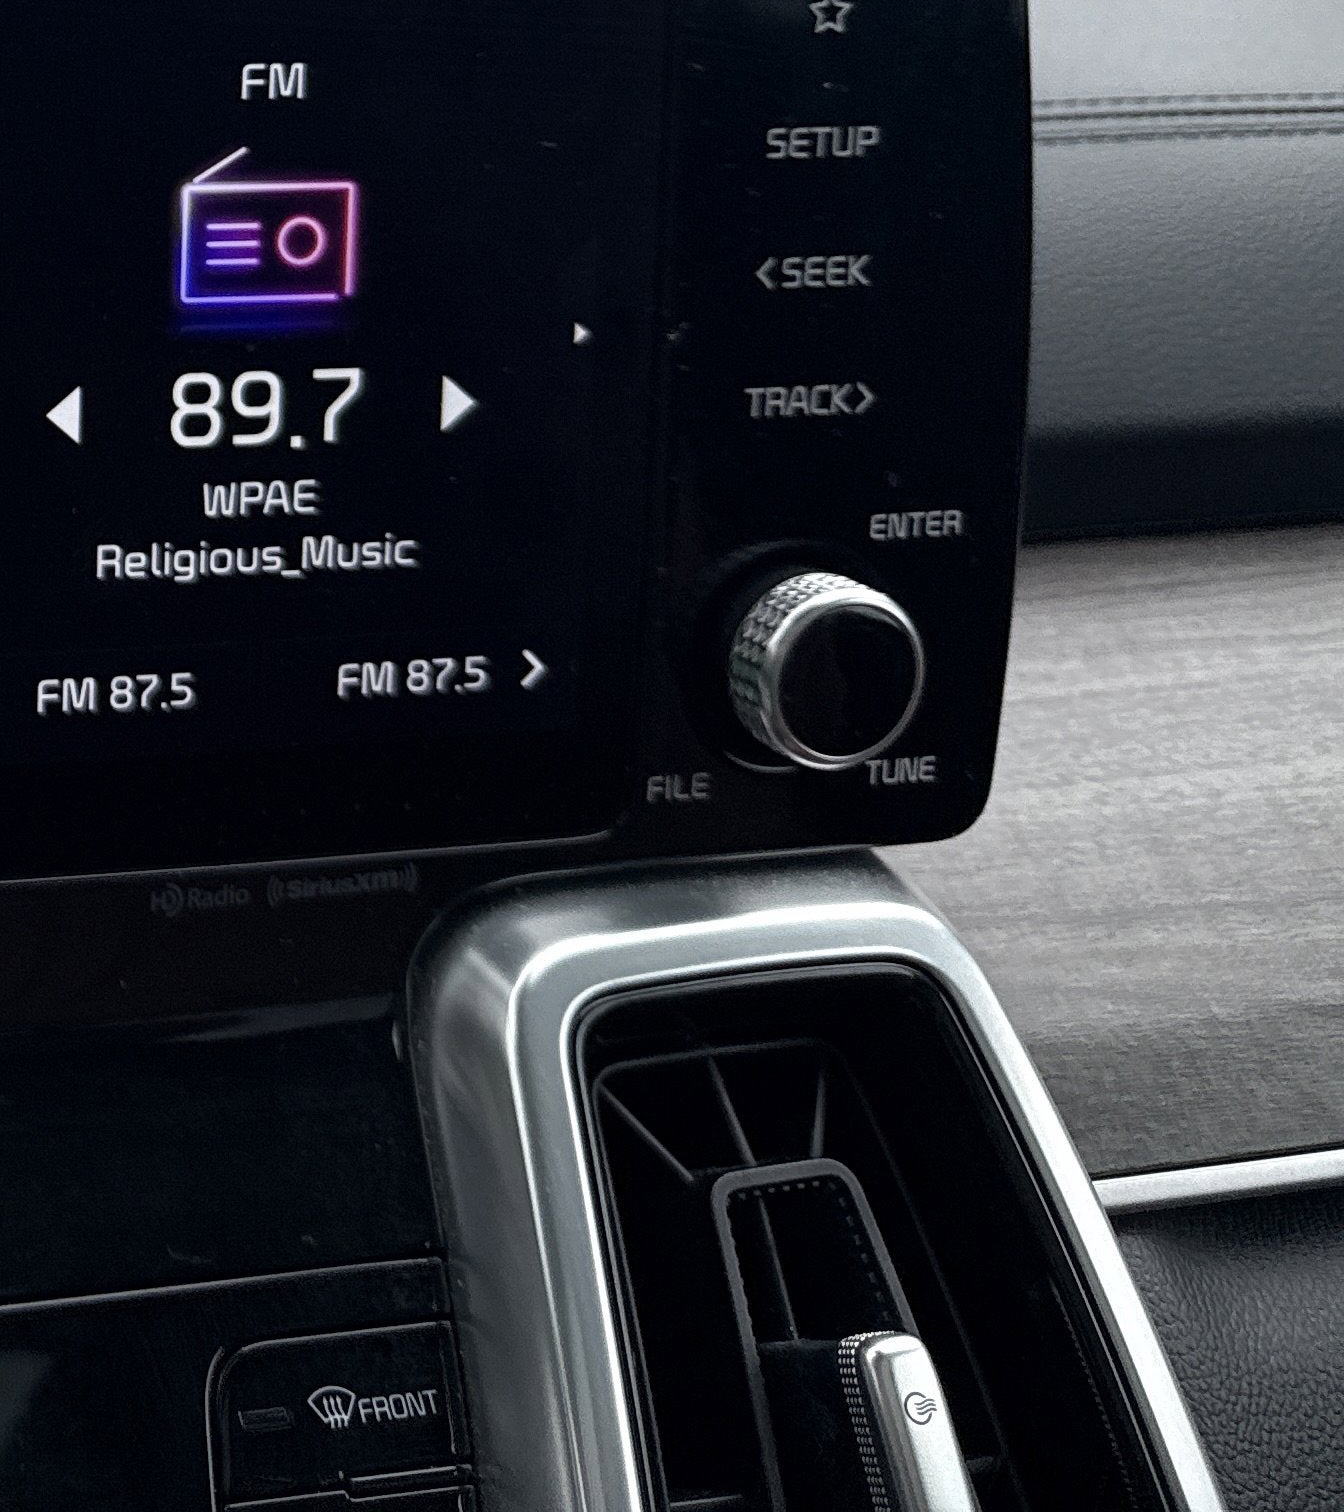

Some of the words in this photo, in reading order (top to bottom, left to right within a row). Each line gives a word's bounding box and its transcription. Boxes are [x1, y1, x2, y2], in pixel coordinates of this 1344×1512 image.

[241, 62, 308, 100] FM
[766, 126, 880, 159] SETUP
[170, 368, 364, 449] 89.7
[203, 479, 320, 518] WPAE
[870, 510, 963, 541] ENTER
[96, 533, 421, 584] Religious_Music
[37, 677, 97, 714] FM
[109, 672, 196, 710] 87.5
[337, 661, 395, 698] FM
[406, 655, 490, 694] 87.5
[645, 774, 709, 804] FILE
[865, 757, 937, 785] TUNE
[187, 884, 251, 909] Radio
[358, 1389, 437, 1423] FRONT
